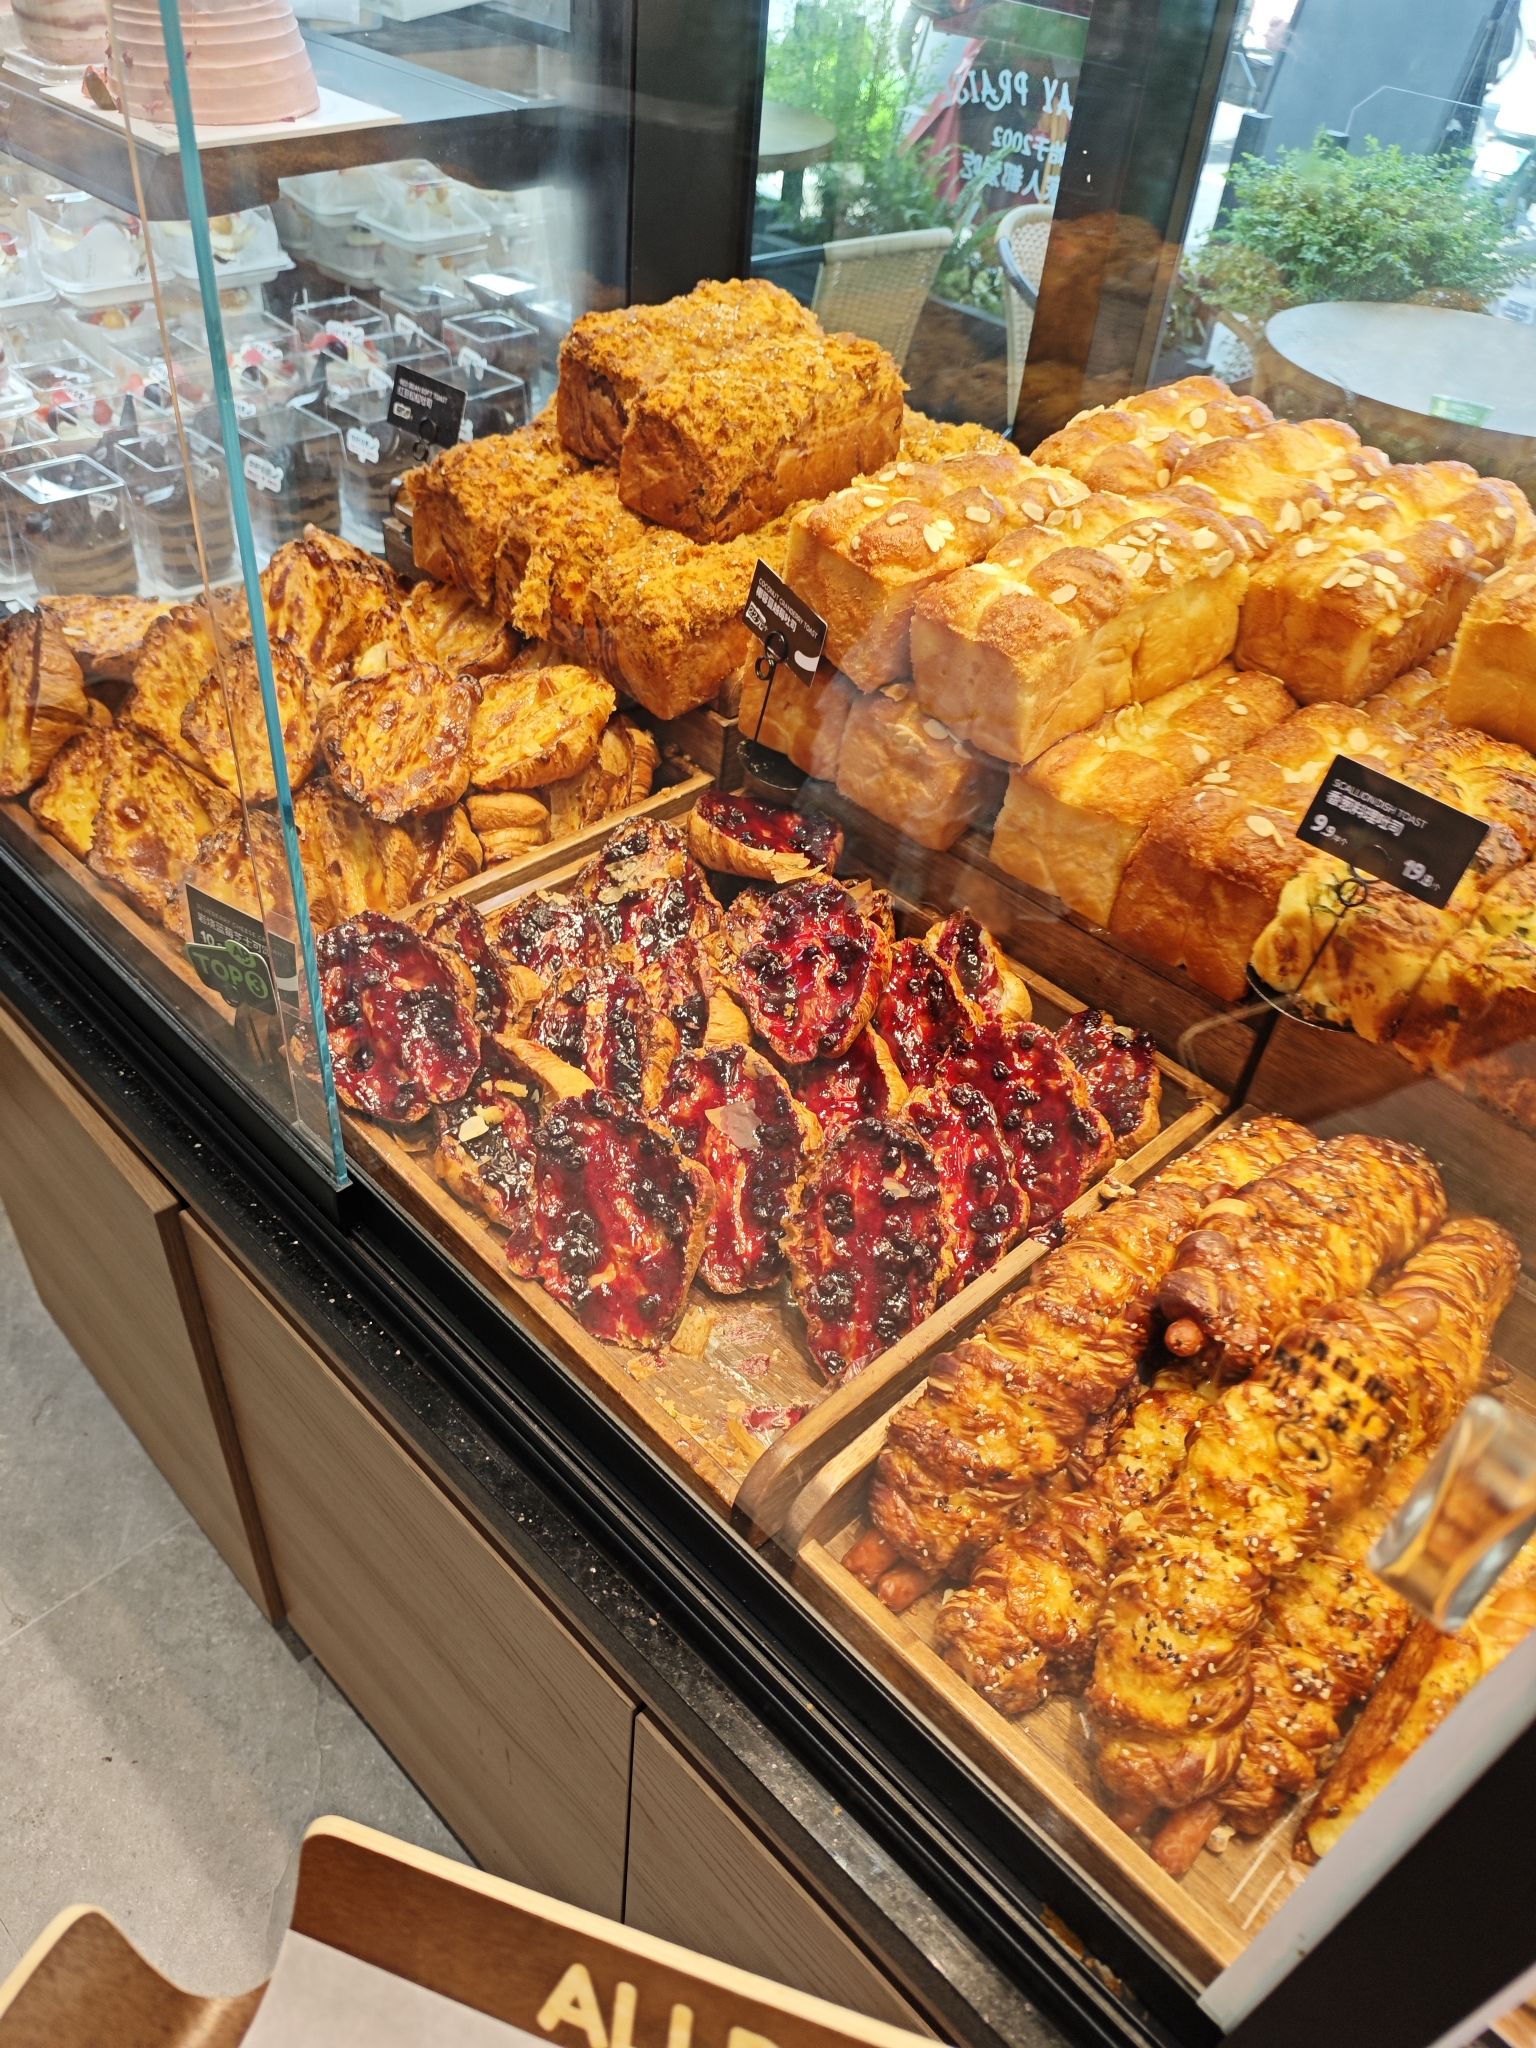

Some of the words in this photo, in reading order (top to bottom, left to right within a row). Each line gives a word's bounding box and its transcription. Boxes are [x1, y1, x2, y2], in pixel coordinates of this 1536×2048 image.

[758, 578, 779, 600] COCONUT
[803, 621, 818, 639] TOAST
[1395, 808, 1429, 829] TOAST
